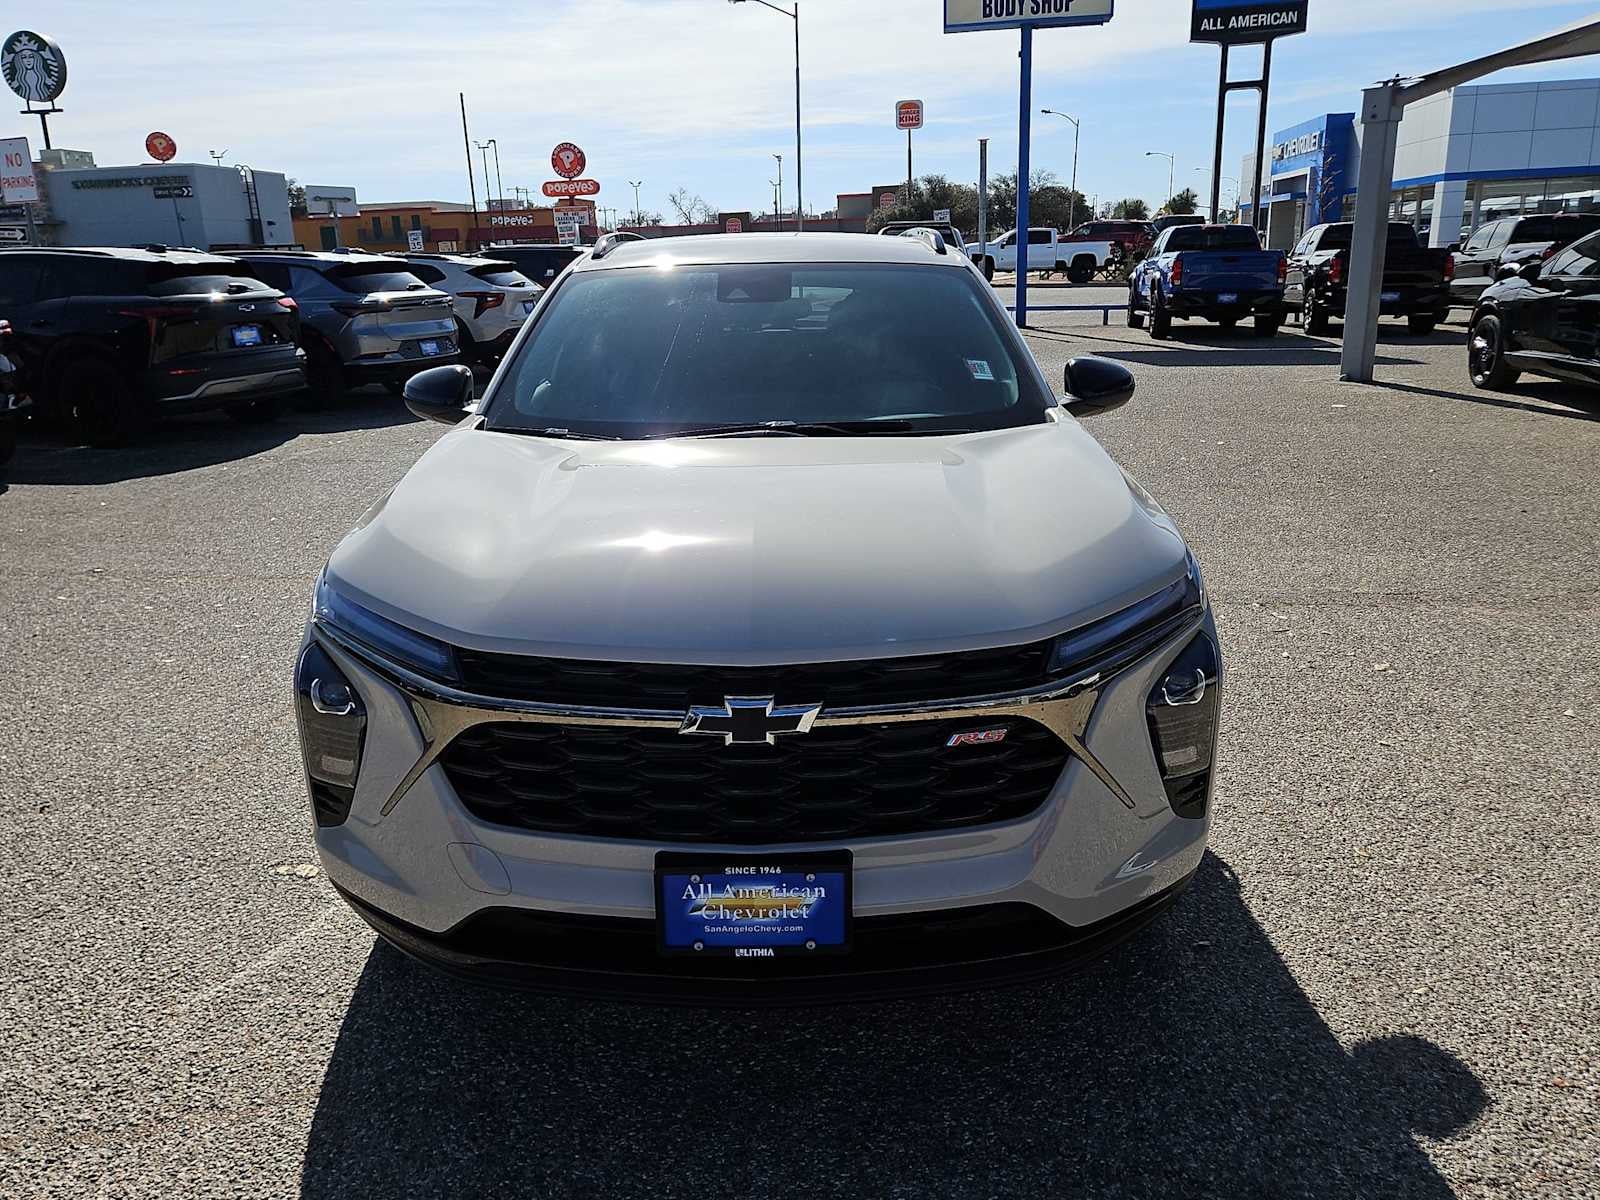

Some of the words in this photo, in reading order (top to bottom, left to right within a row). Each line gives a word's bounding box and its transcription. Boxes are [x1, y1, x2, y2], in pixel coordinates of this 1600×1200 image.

[982, 0, 1025, 18] BODY
[1030, 0, 1074, 14] SHOP
[1200, 17, 1225, 31] ALL
[1228, 11, 1298, 29] AMERICAN
[899, 114, 920, 122] KING
[1283, 131, 1320, 159] CHEVROLET
[5, 152, 23, 167] NO
[1, 175, 35, 188] PARKING
[411, 241, 422, 249] 35
[725, 867, 756, 875] SINCE
[760, 866, 782, 874] 1946
[681, 883, 713, 900] All
[722, 883, 827, 900] American
[701, 904, 809, 921] Chevrolet
[704, 925, 804, 935] SanAngeloChevy.com
